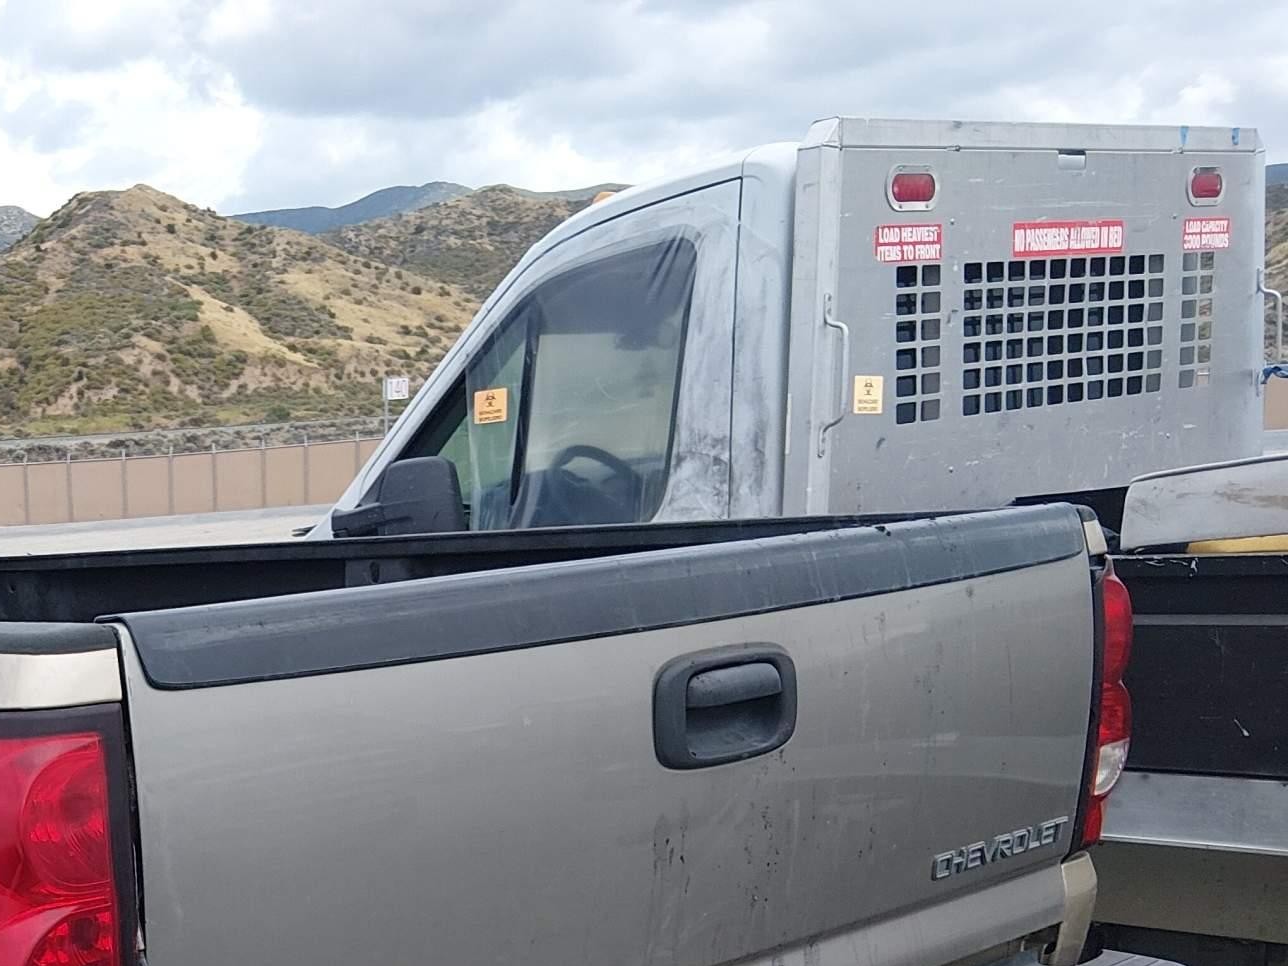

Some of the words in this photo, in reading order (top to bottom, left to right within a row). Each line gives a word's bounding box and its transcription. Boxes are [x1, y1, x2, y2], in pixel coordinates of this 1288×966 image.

[878, 227, 900, 243] LOAD
[900, 226, 939, 243] HEAVIEST
[1185, 220, 1201, 233] LOAD
[1201, 219, 1228, 232] CAPACITY
[1014, 229, 1025, 252] NO
[1025, 227, 1069, 251] PASSENGERS
[1069, 226, 1100, 249] ALLOWED
[1100, 226, 1109, 248] IN
[1108, 226, 1122, 248] BED
[1201, 232, 1229, 249] POUNDS
[876, 245, 902, 261] ITEMS
[902, 245, 915, 260] TO
[915, 244, 941, 260] FRONT
[931, 816, 1069, 881] CHEVROLET
